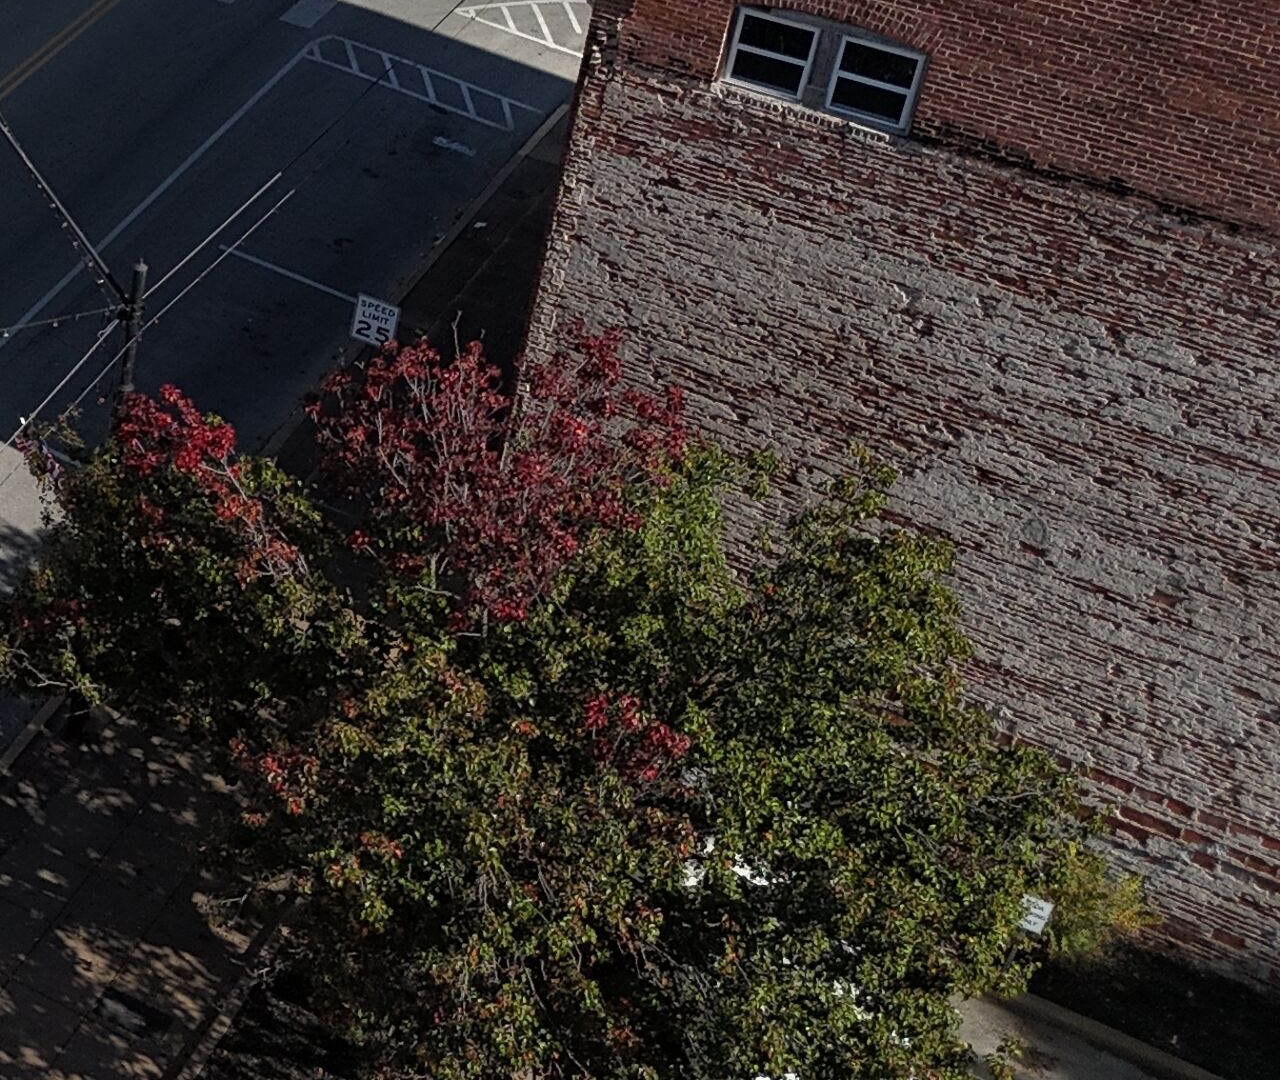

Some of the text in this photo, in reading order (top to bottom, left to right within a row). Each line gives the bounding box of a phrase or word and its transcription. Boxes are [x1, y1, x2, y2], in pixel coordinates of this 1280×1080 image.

[360, 300, 396, 318] SPEED
[362, 310, 390, 326] LIMIT
[355, 320, 391, 343] 25
